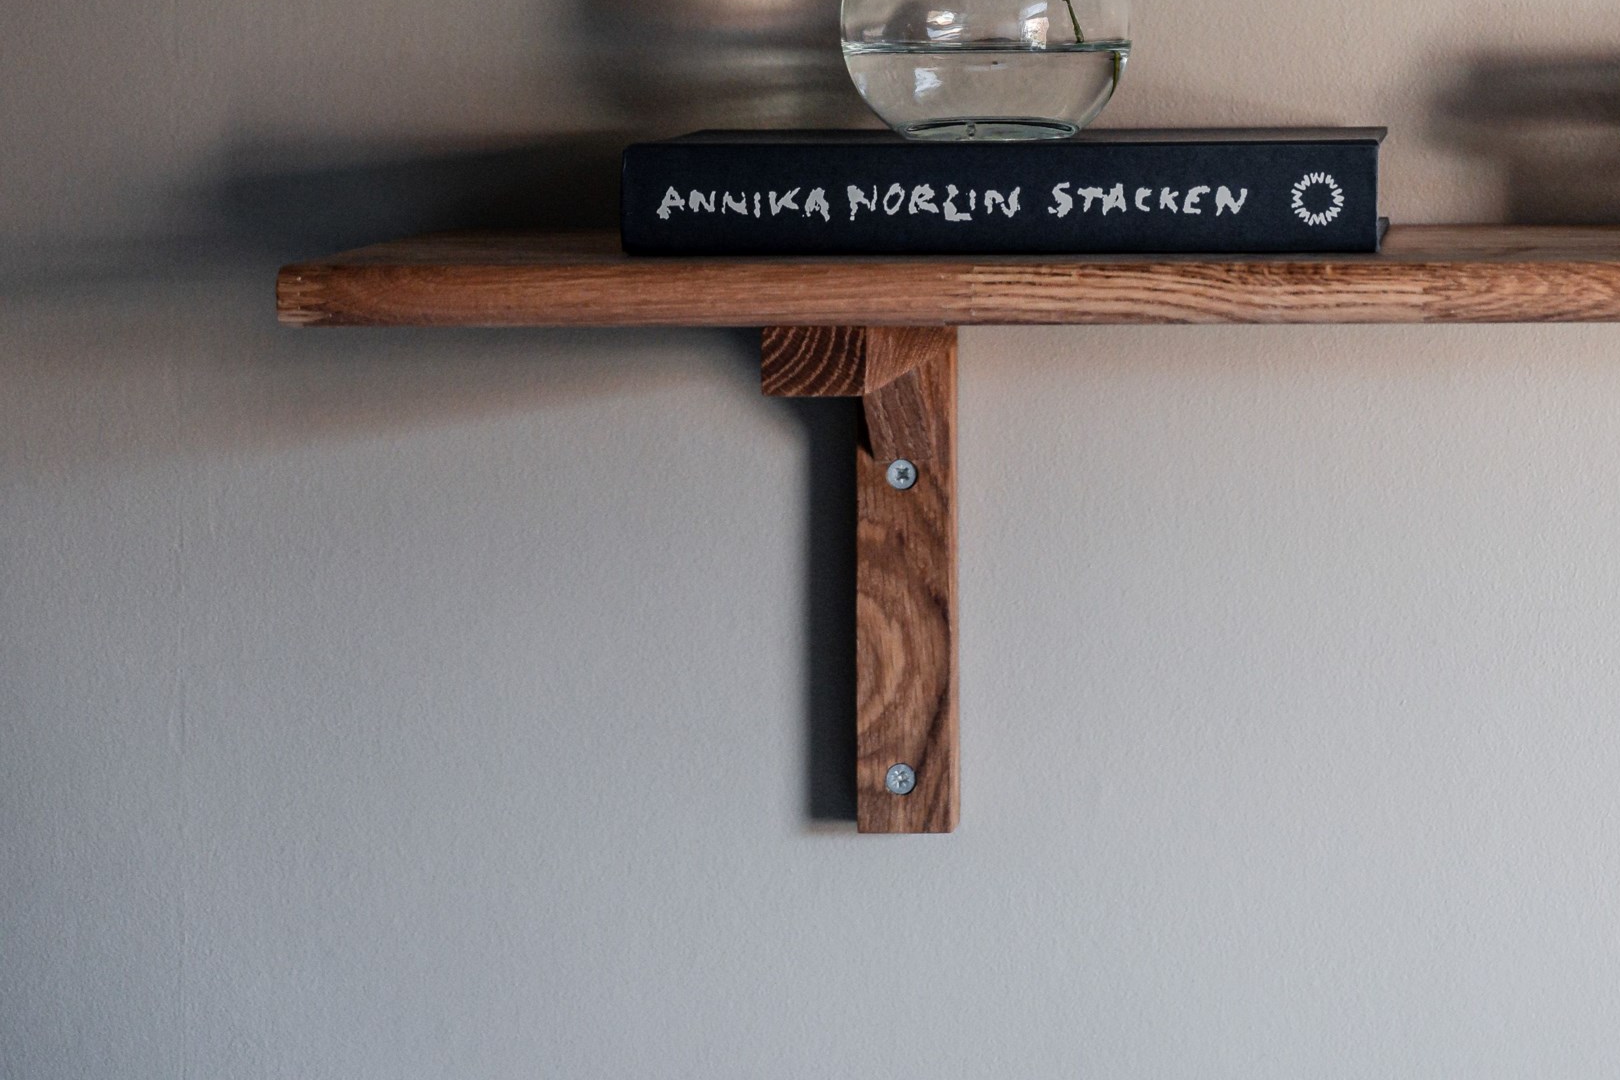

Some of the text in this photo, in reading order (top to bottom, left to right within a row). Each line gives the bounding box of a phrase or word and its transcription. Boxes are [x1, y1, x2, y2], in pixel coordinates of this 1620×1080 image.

[656, 181, 1248, 222] ANNIKA NORLIN STACKEN
